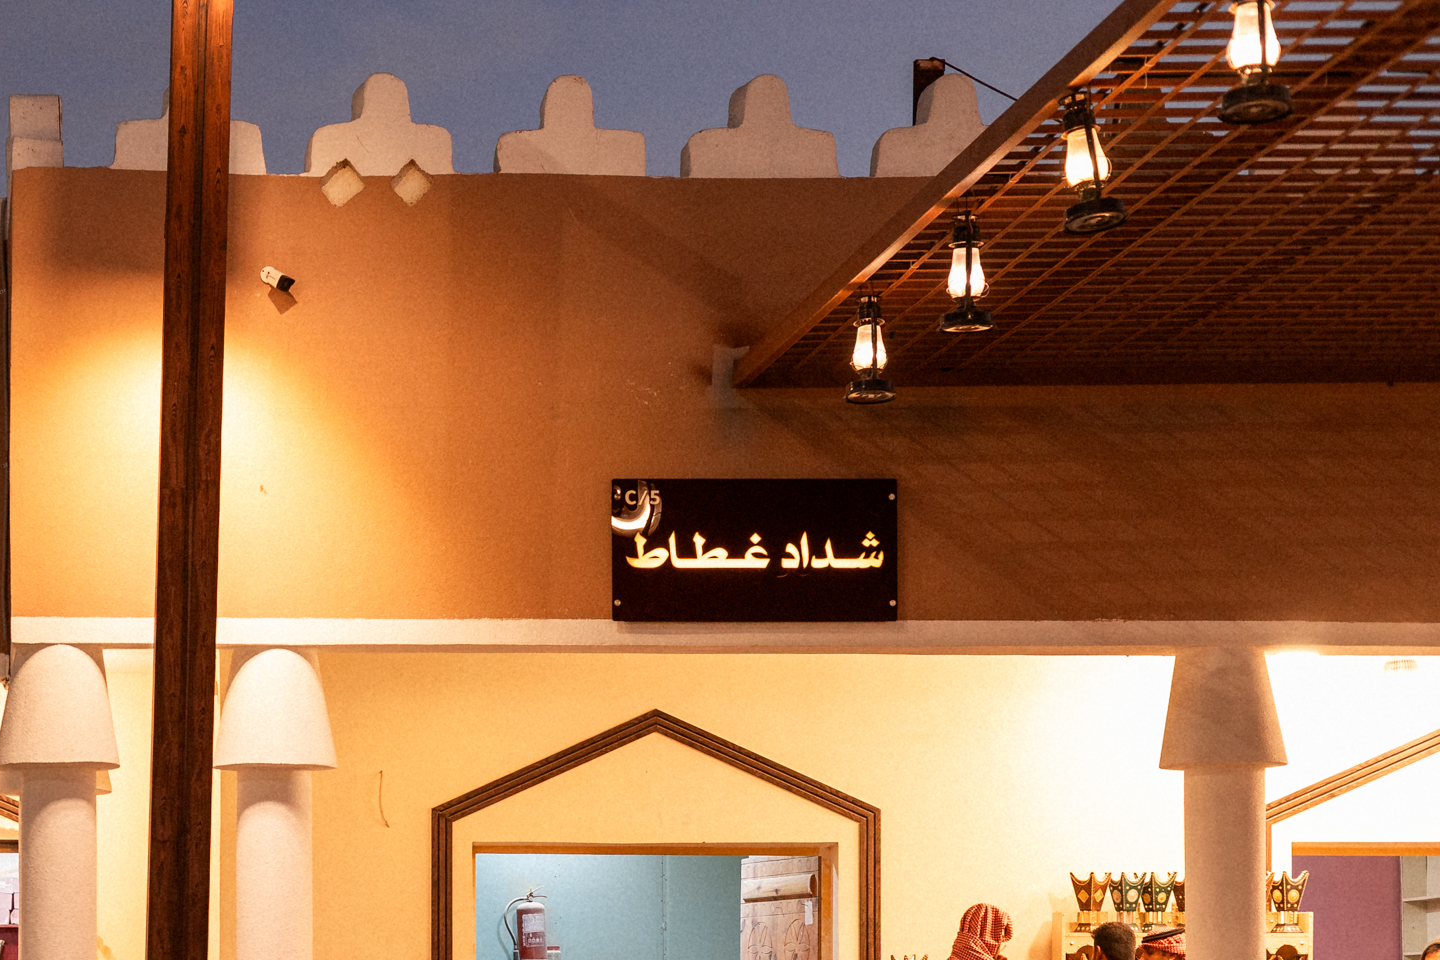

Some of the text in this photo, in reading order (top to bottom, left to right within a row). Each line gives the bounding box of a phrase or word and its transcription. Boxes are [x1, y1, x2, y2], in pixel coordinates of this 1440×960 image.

[625, 489, 661, 505] C/5
[626, 530, 884, 569] شداد غطاط
